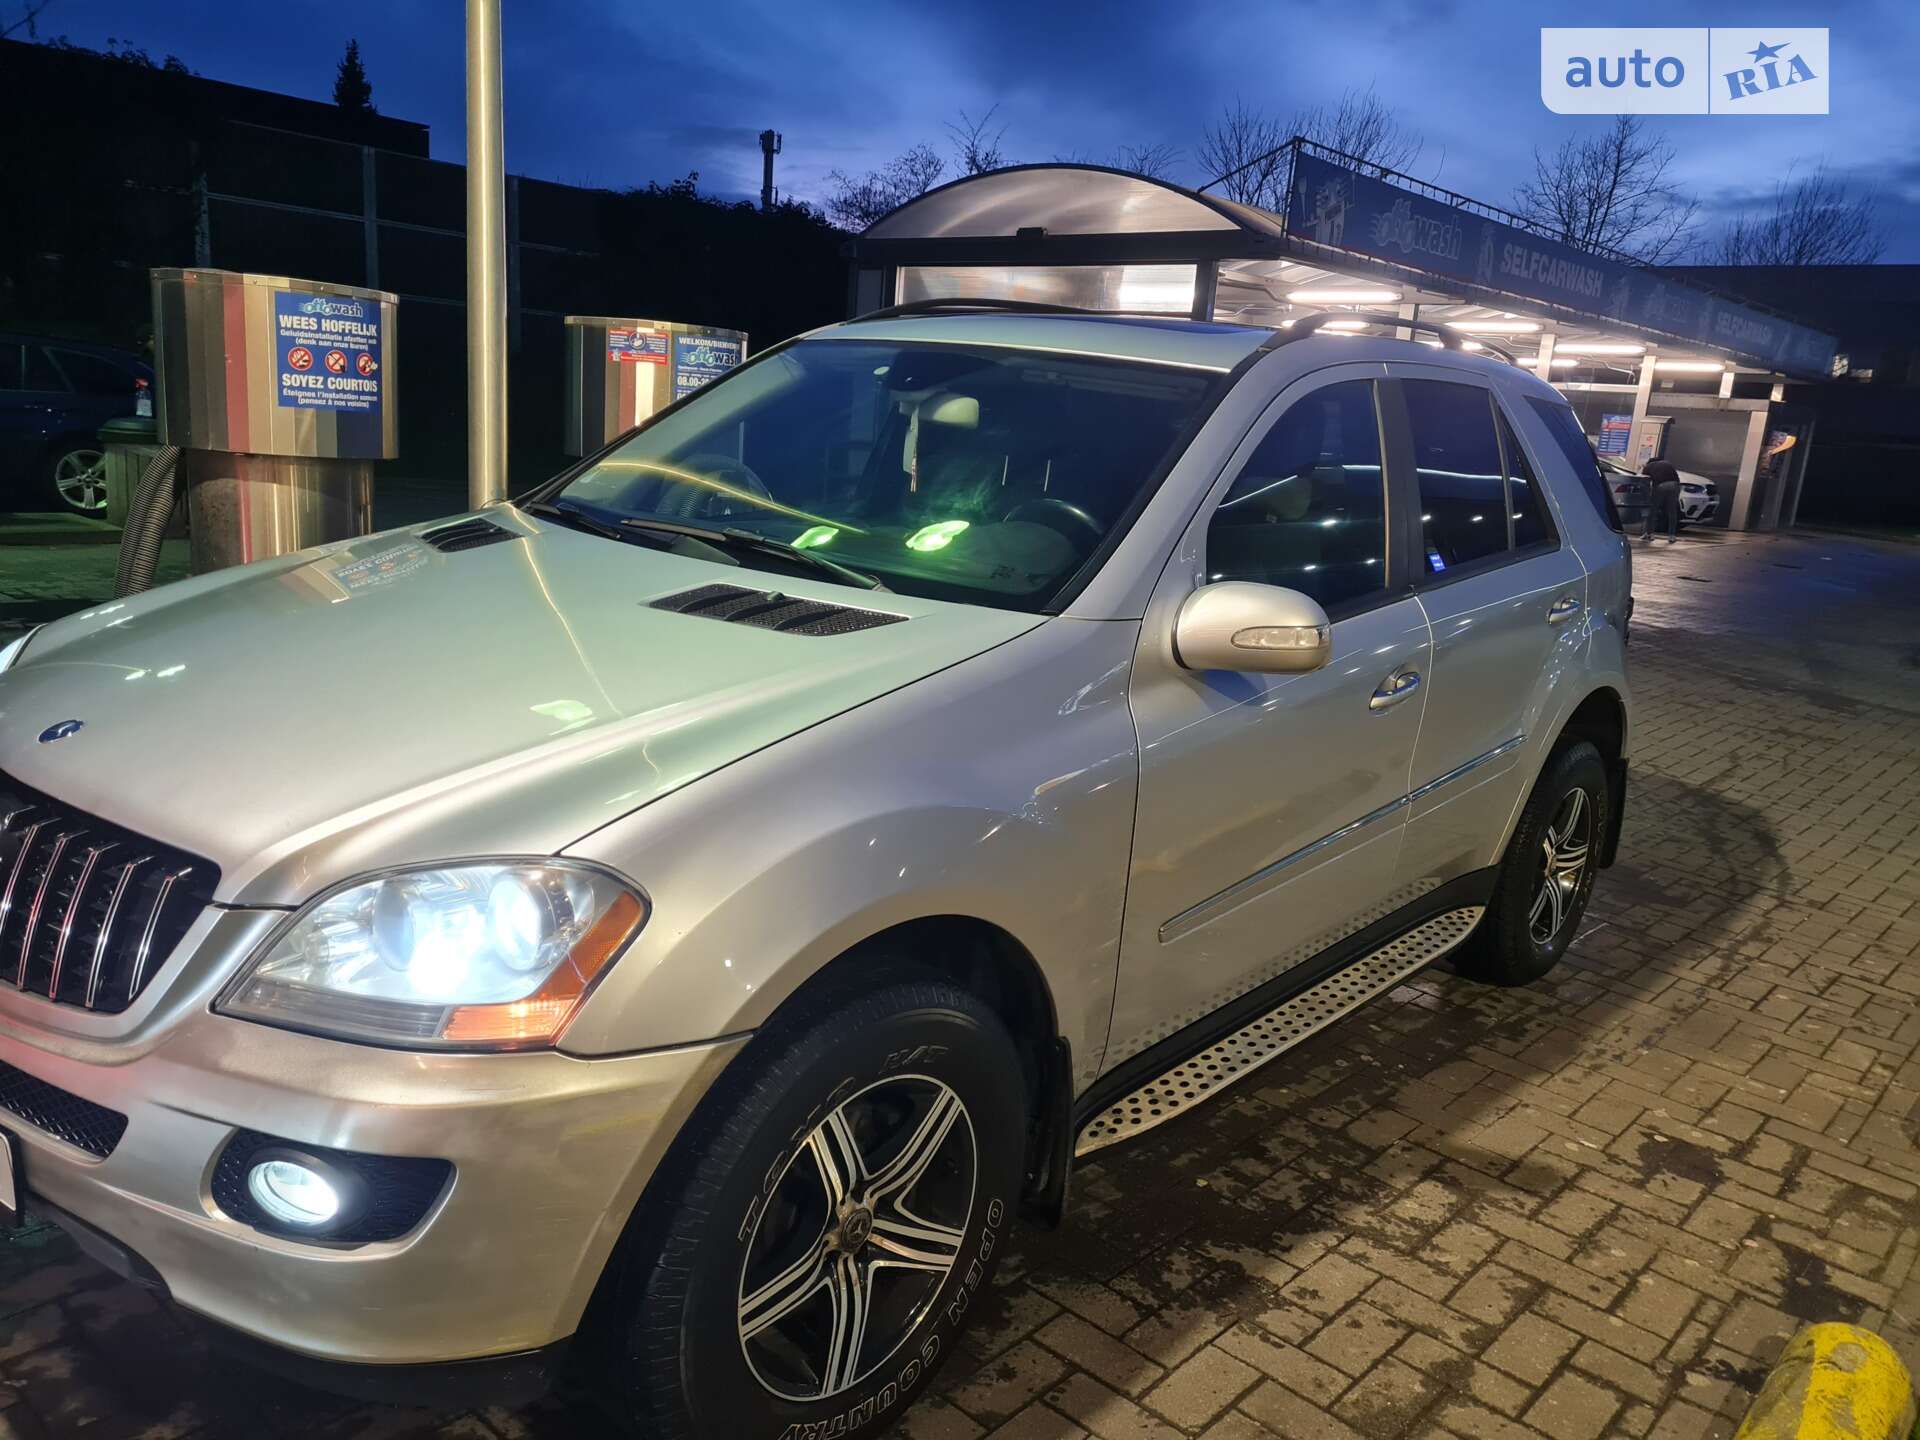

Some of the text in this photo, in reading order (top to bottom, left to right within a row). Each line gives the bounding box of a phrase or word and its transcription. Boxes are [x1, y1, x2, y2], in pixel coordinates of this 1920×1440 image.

[1500, 243, 1605, 299] SELFCARWASH
[279, 315, 378, 337] WEES HOFFELIJK
[282, 373, 378, 393] SOYEZ COURTOIS
[947, 1198, 1005, 1327] OPEN
